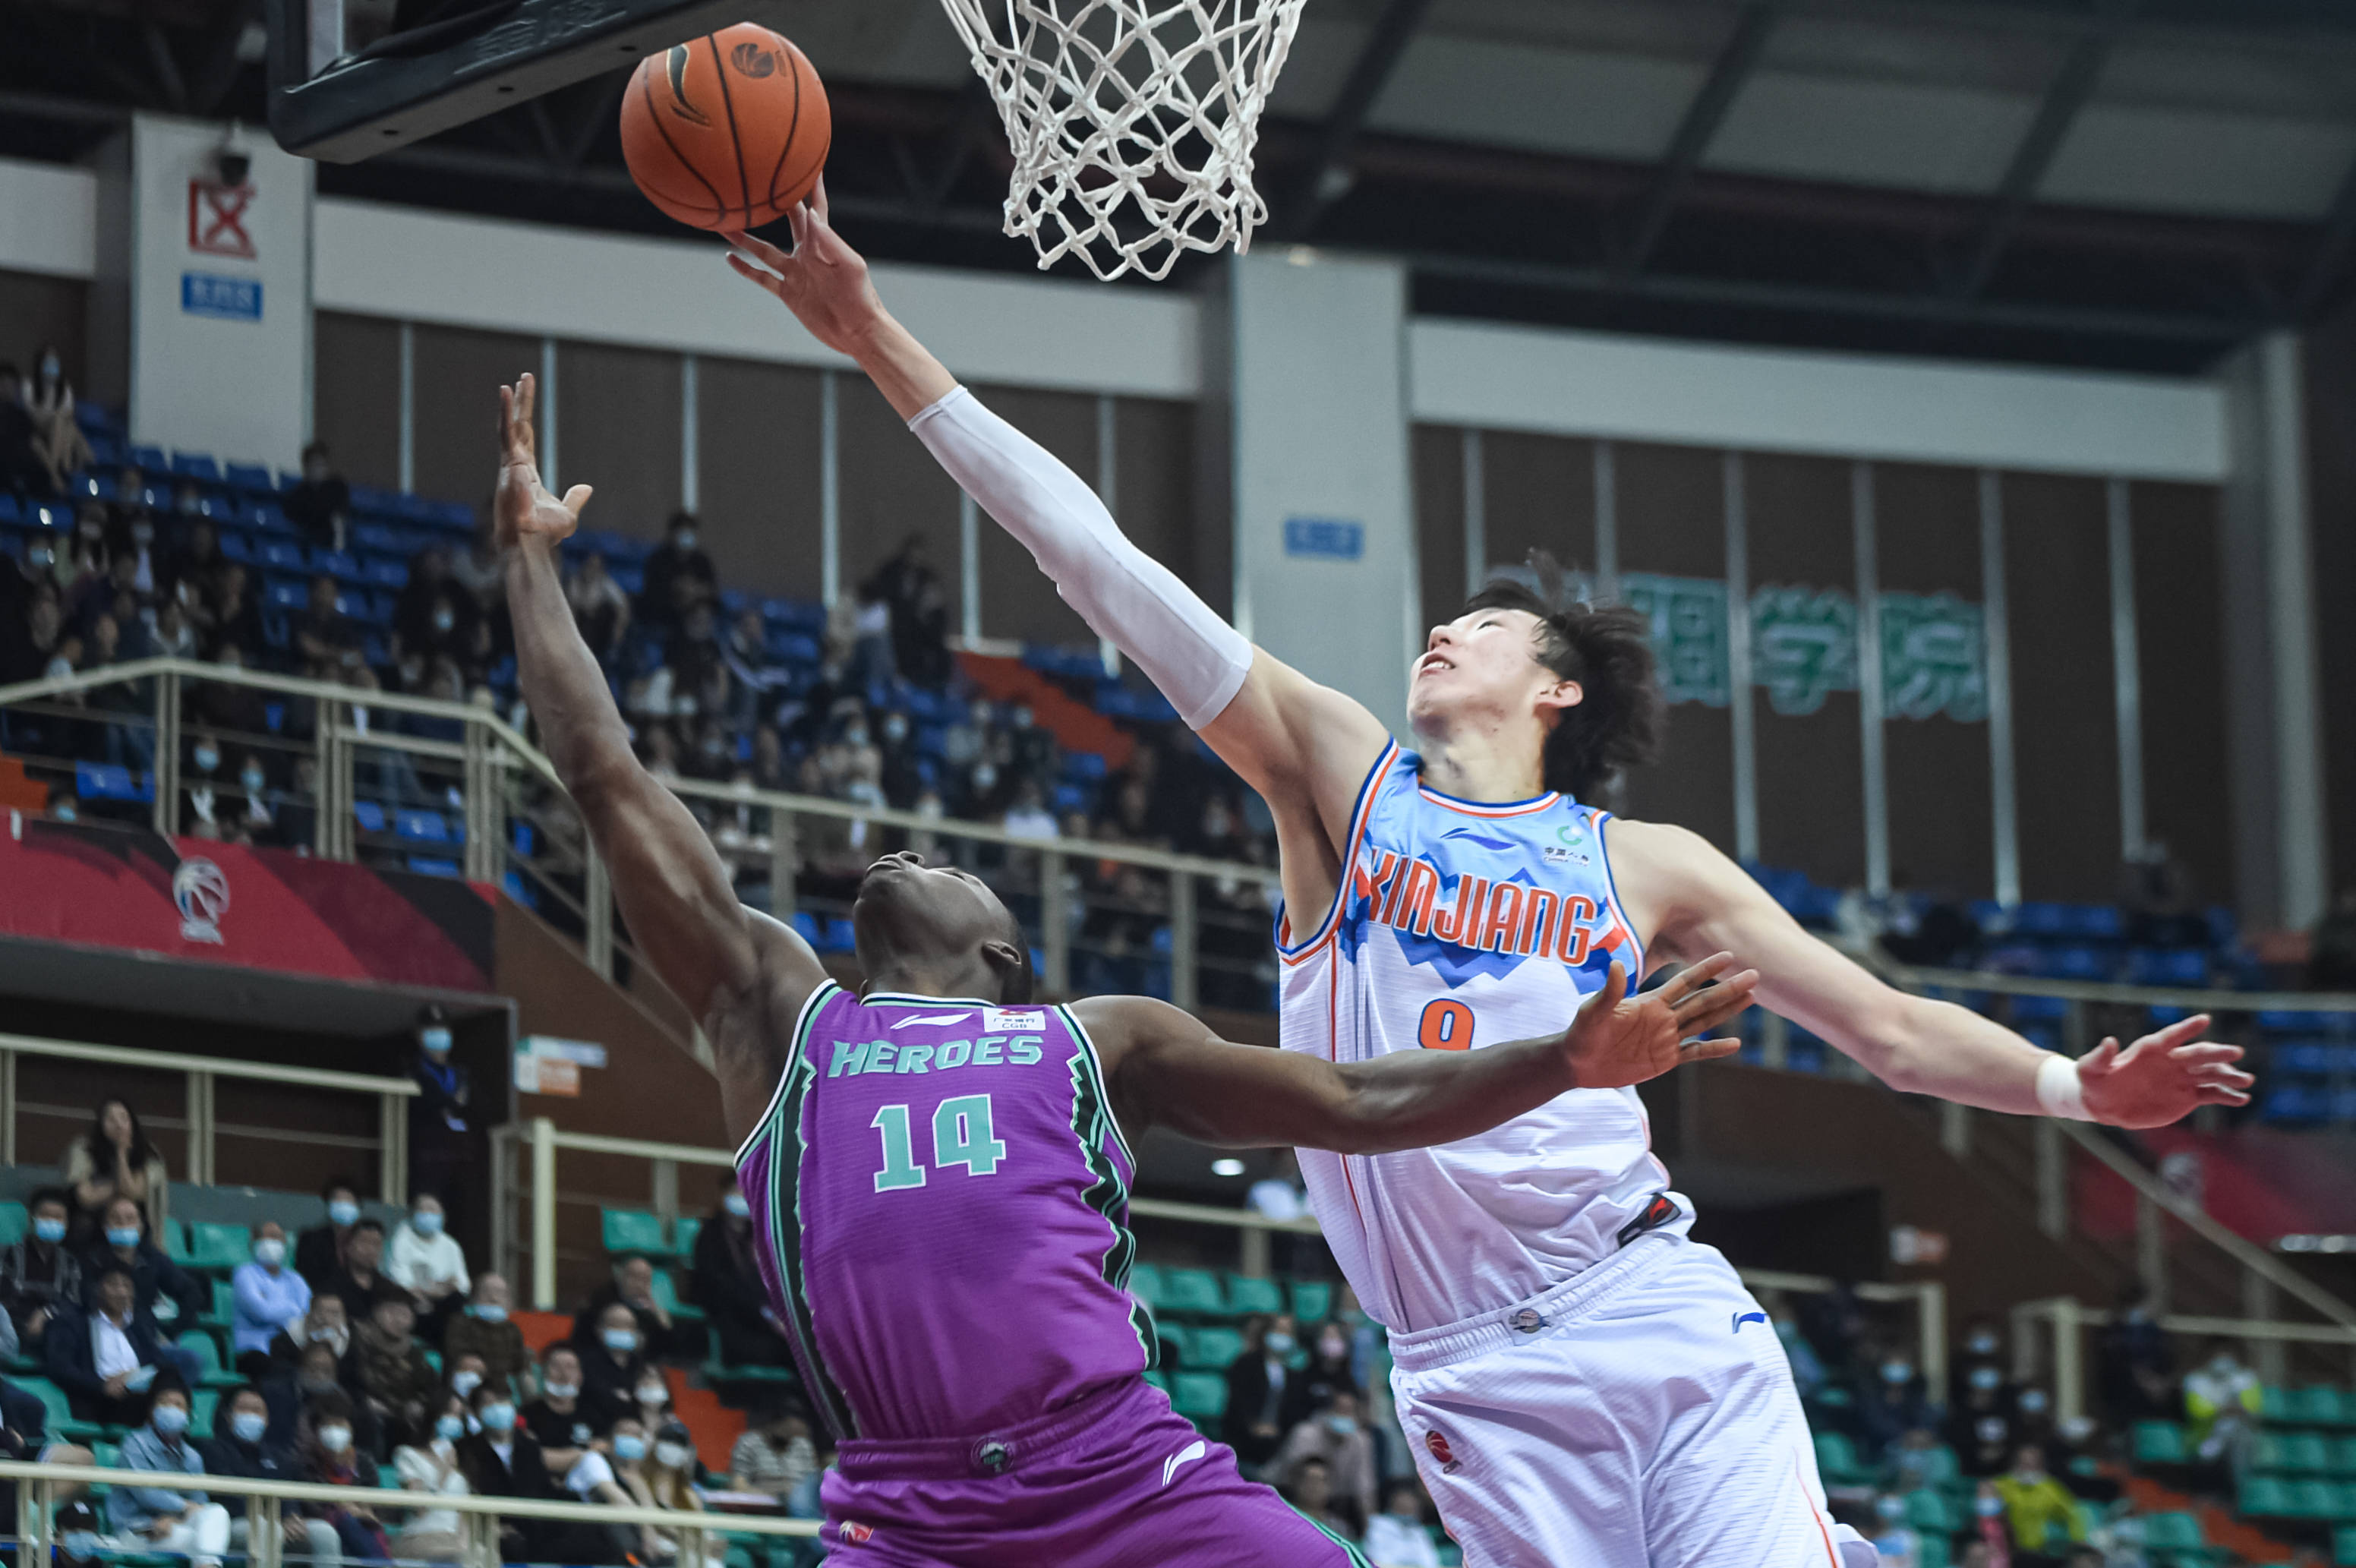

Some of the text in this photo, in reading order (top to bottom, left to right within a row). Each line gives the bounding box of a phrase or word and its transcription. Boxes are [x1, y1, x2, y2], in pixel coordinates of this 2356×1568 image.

[1367, 845, 1598, 967] XINJIANG
[827, 1035, 1045, 1079] HEROES
[869, 1093, 1007, 1194] 14
